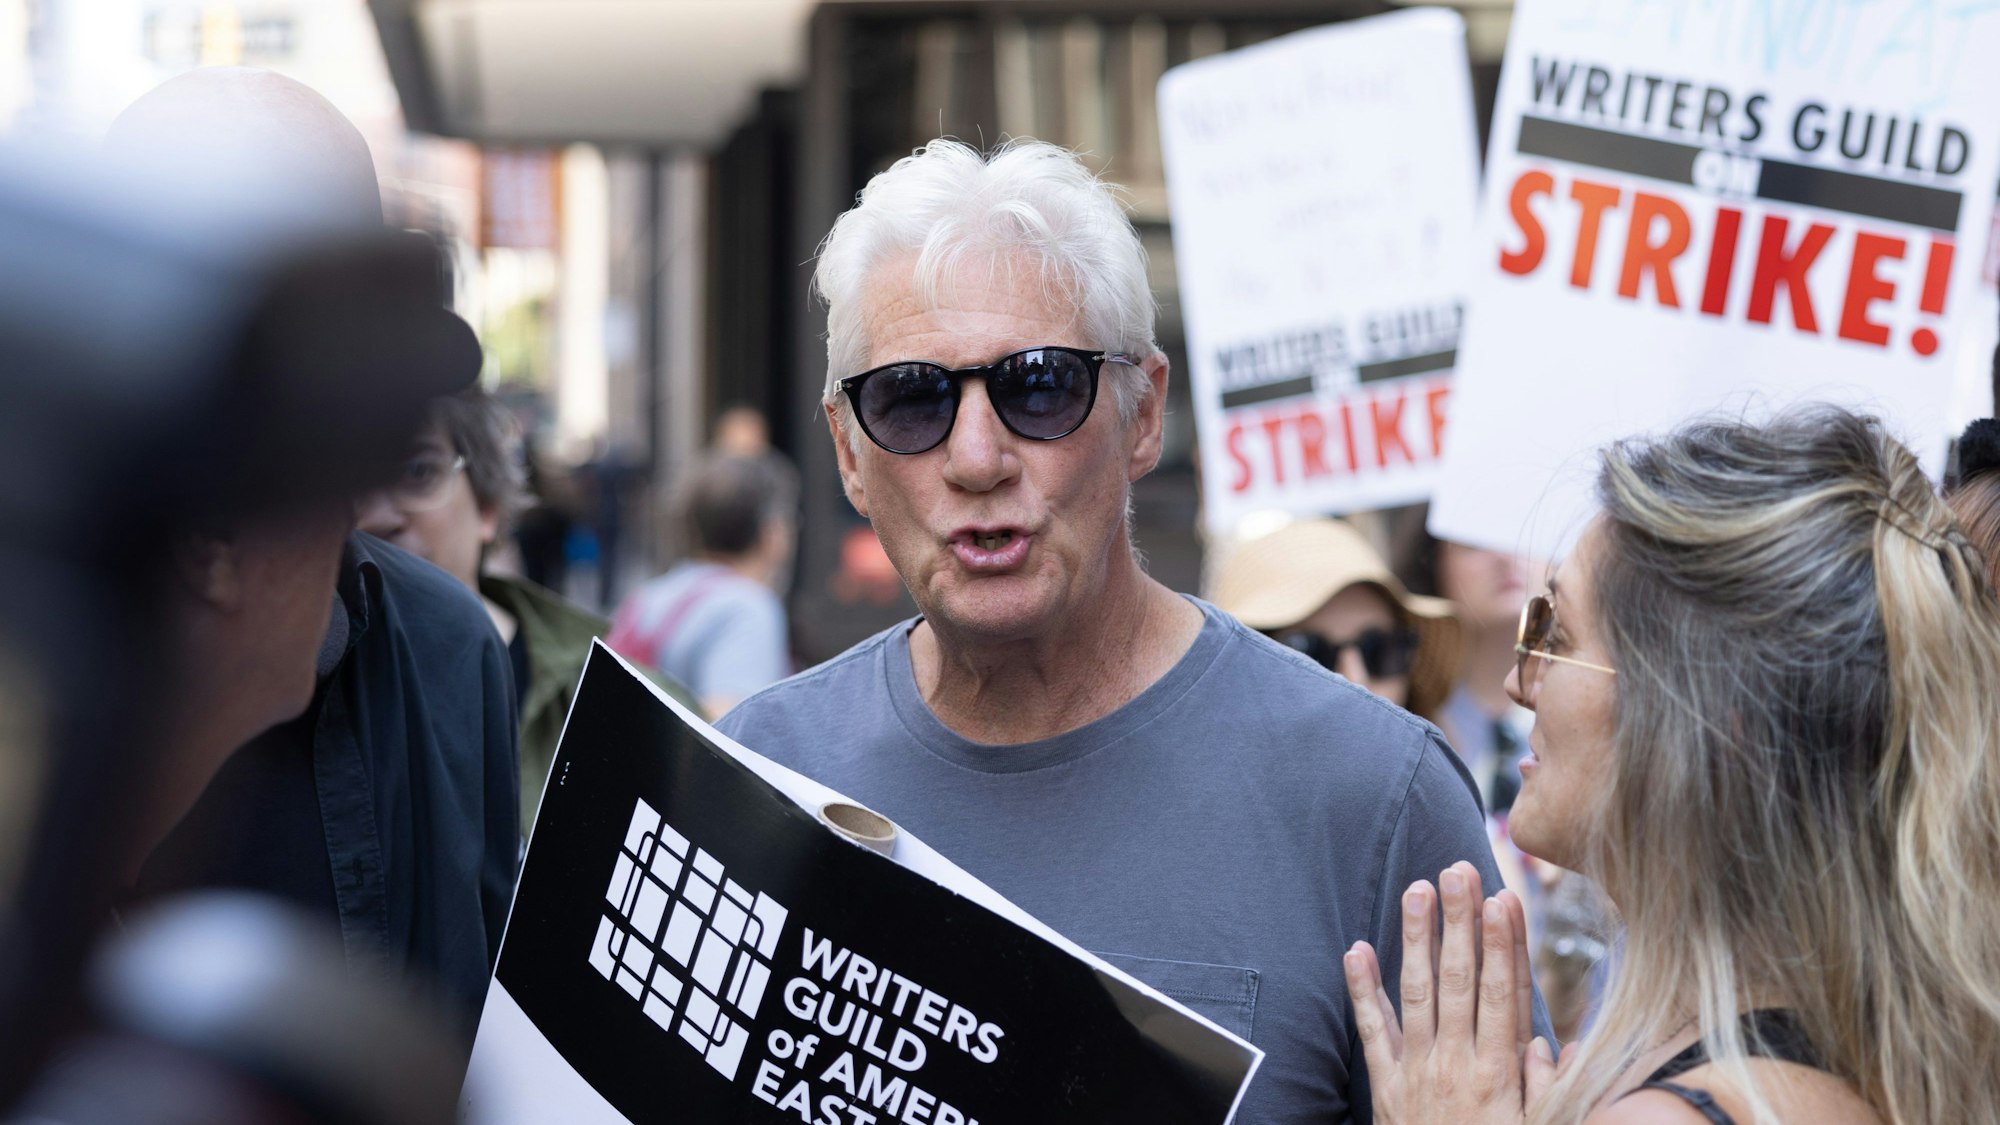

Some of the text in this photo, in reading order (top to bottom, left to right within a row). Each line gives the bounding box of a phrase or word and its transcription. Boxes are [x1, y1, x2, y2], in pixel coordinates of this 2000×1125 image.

[1531, 54, 1970, 177] WRITERS GUILD
[1499, 170, 1956, 358] STRIKE!
[784, 977, 927, 1072] GUILD
[802, 927, 1004, 1064] WRITERS
[751, 1058, 877, 1125] EAST
[767, 1029, 979, 1125] of AMER
